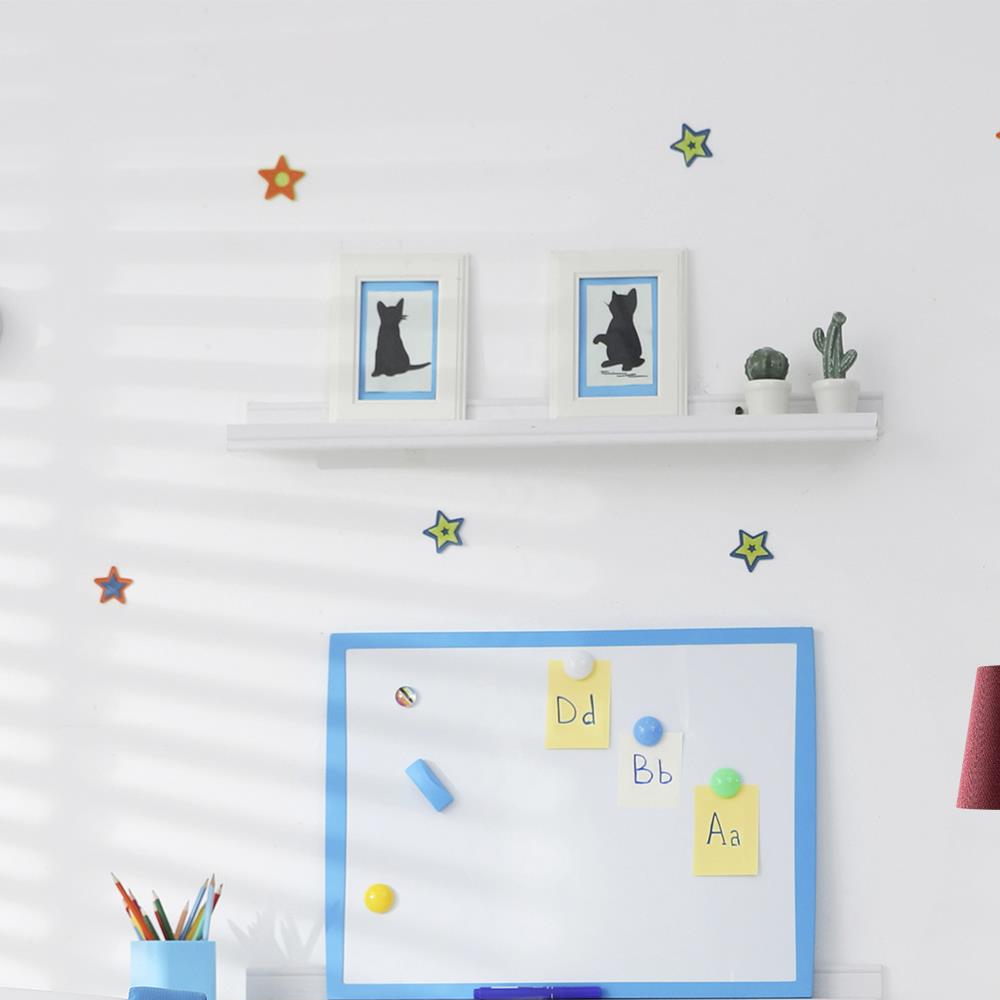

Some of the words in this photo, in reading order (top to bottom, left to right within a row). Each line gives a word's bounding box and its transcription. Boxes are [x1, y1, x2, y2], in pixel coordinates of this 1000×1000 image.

[556, 693, 596, 725] Dd
[633, 753, 673, 785] Bb
[706, 811, 741, 846] Aa
